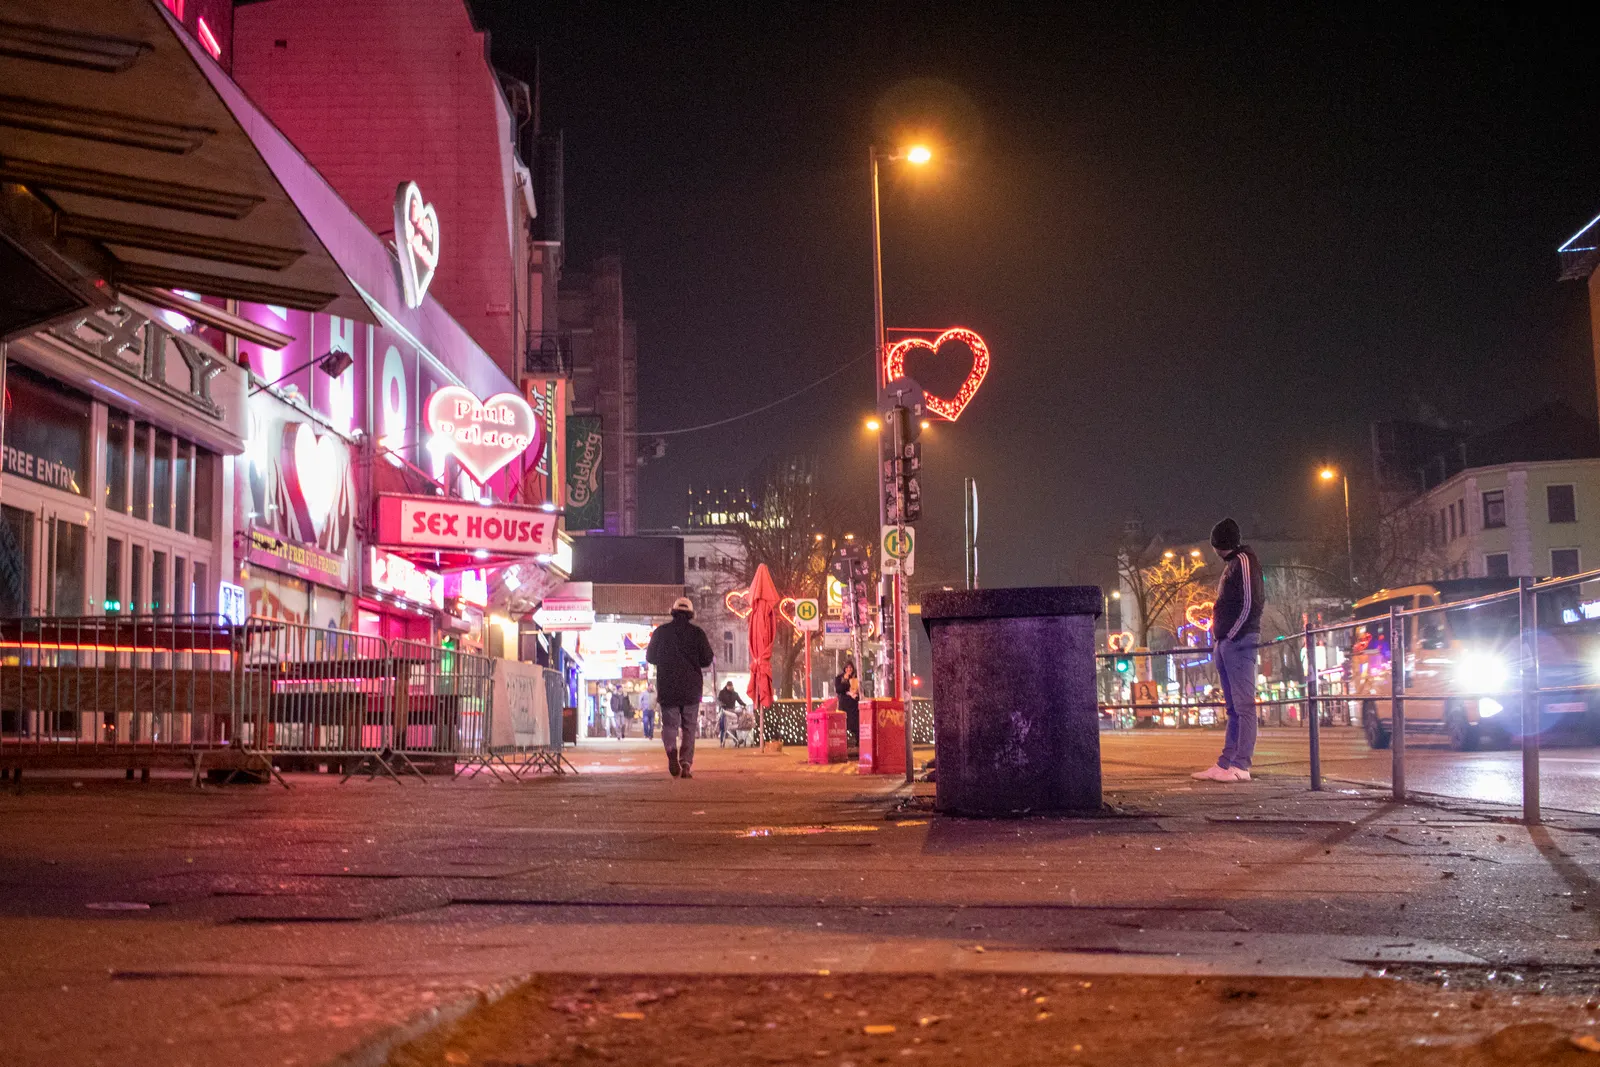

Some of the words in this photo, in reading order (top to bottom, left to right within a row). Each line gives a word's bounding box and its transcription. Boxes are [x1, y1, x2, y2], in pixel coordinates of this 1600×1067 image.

[453, 399, 515, 425] Pink
[438, 420, 528, 451] Palace
[37, 457, 76, 493] ENTRY
[566, 432, 602, 508] Carlsberg
[413, 511, 459, 537] SEX
[467, 515, 544, 544] HOUSE
